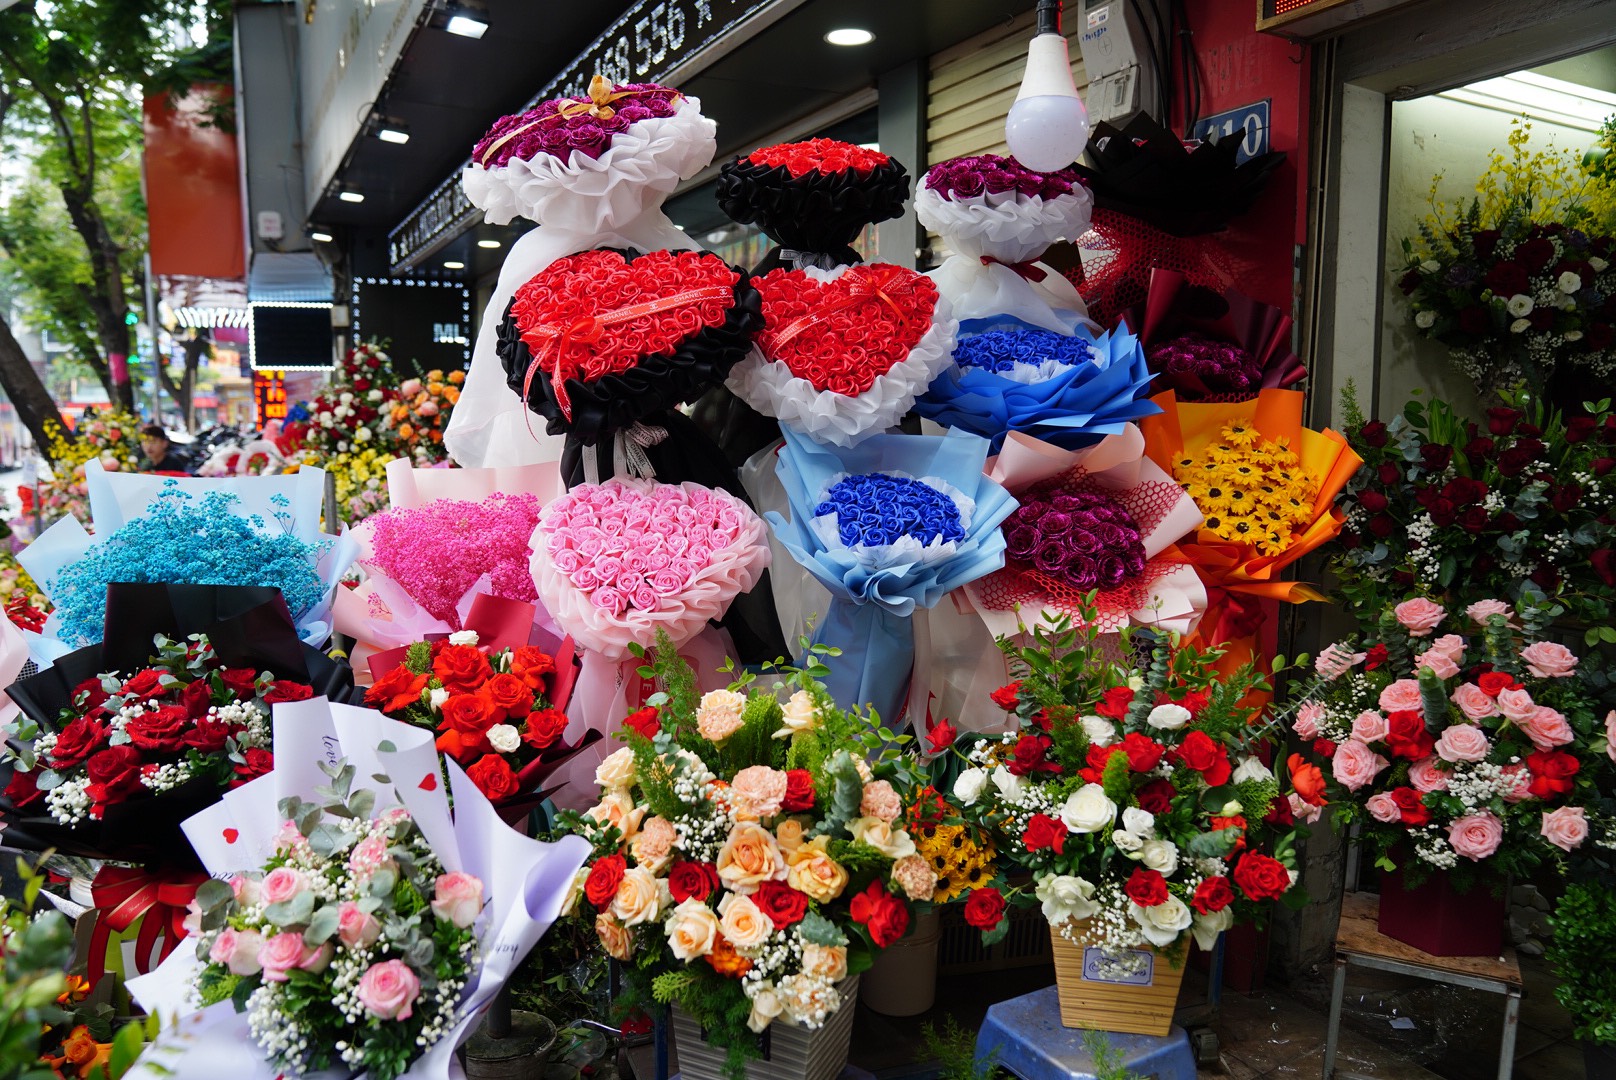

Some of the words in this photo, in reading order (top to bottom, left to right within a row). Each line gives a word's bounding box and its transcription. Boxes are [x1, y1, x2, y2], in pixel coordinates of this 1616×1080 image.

[603, 310, 632, 321] CHANEL
[673, 291, 703, 302] CHANEL
[776, 325, 799, 344] CHANEL
[630, 443, 646, 468] CHANEL
[321, 735, 339, 769] love
